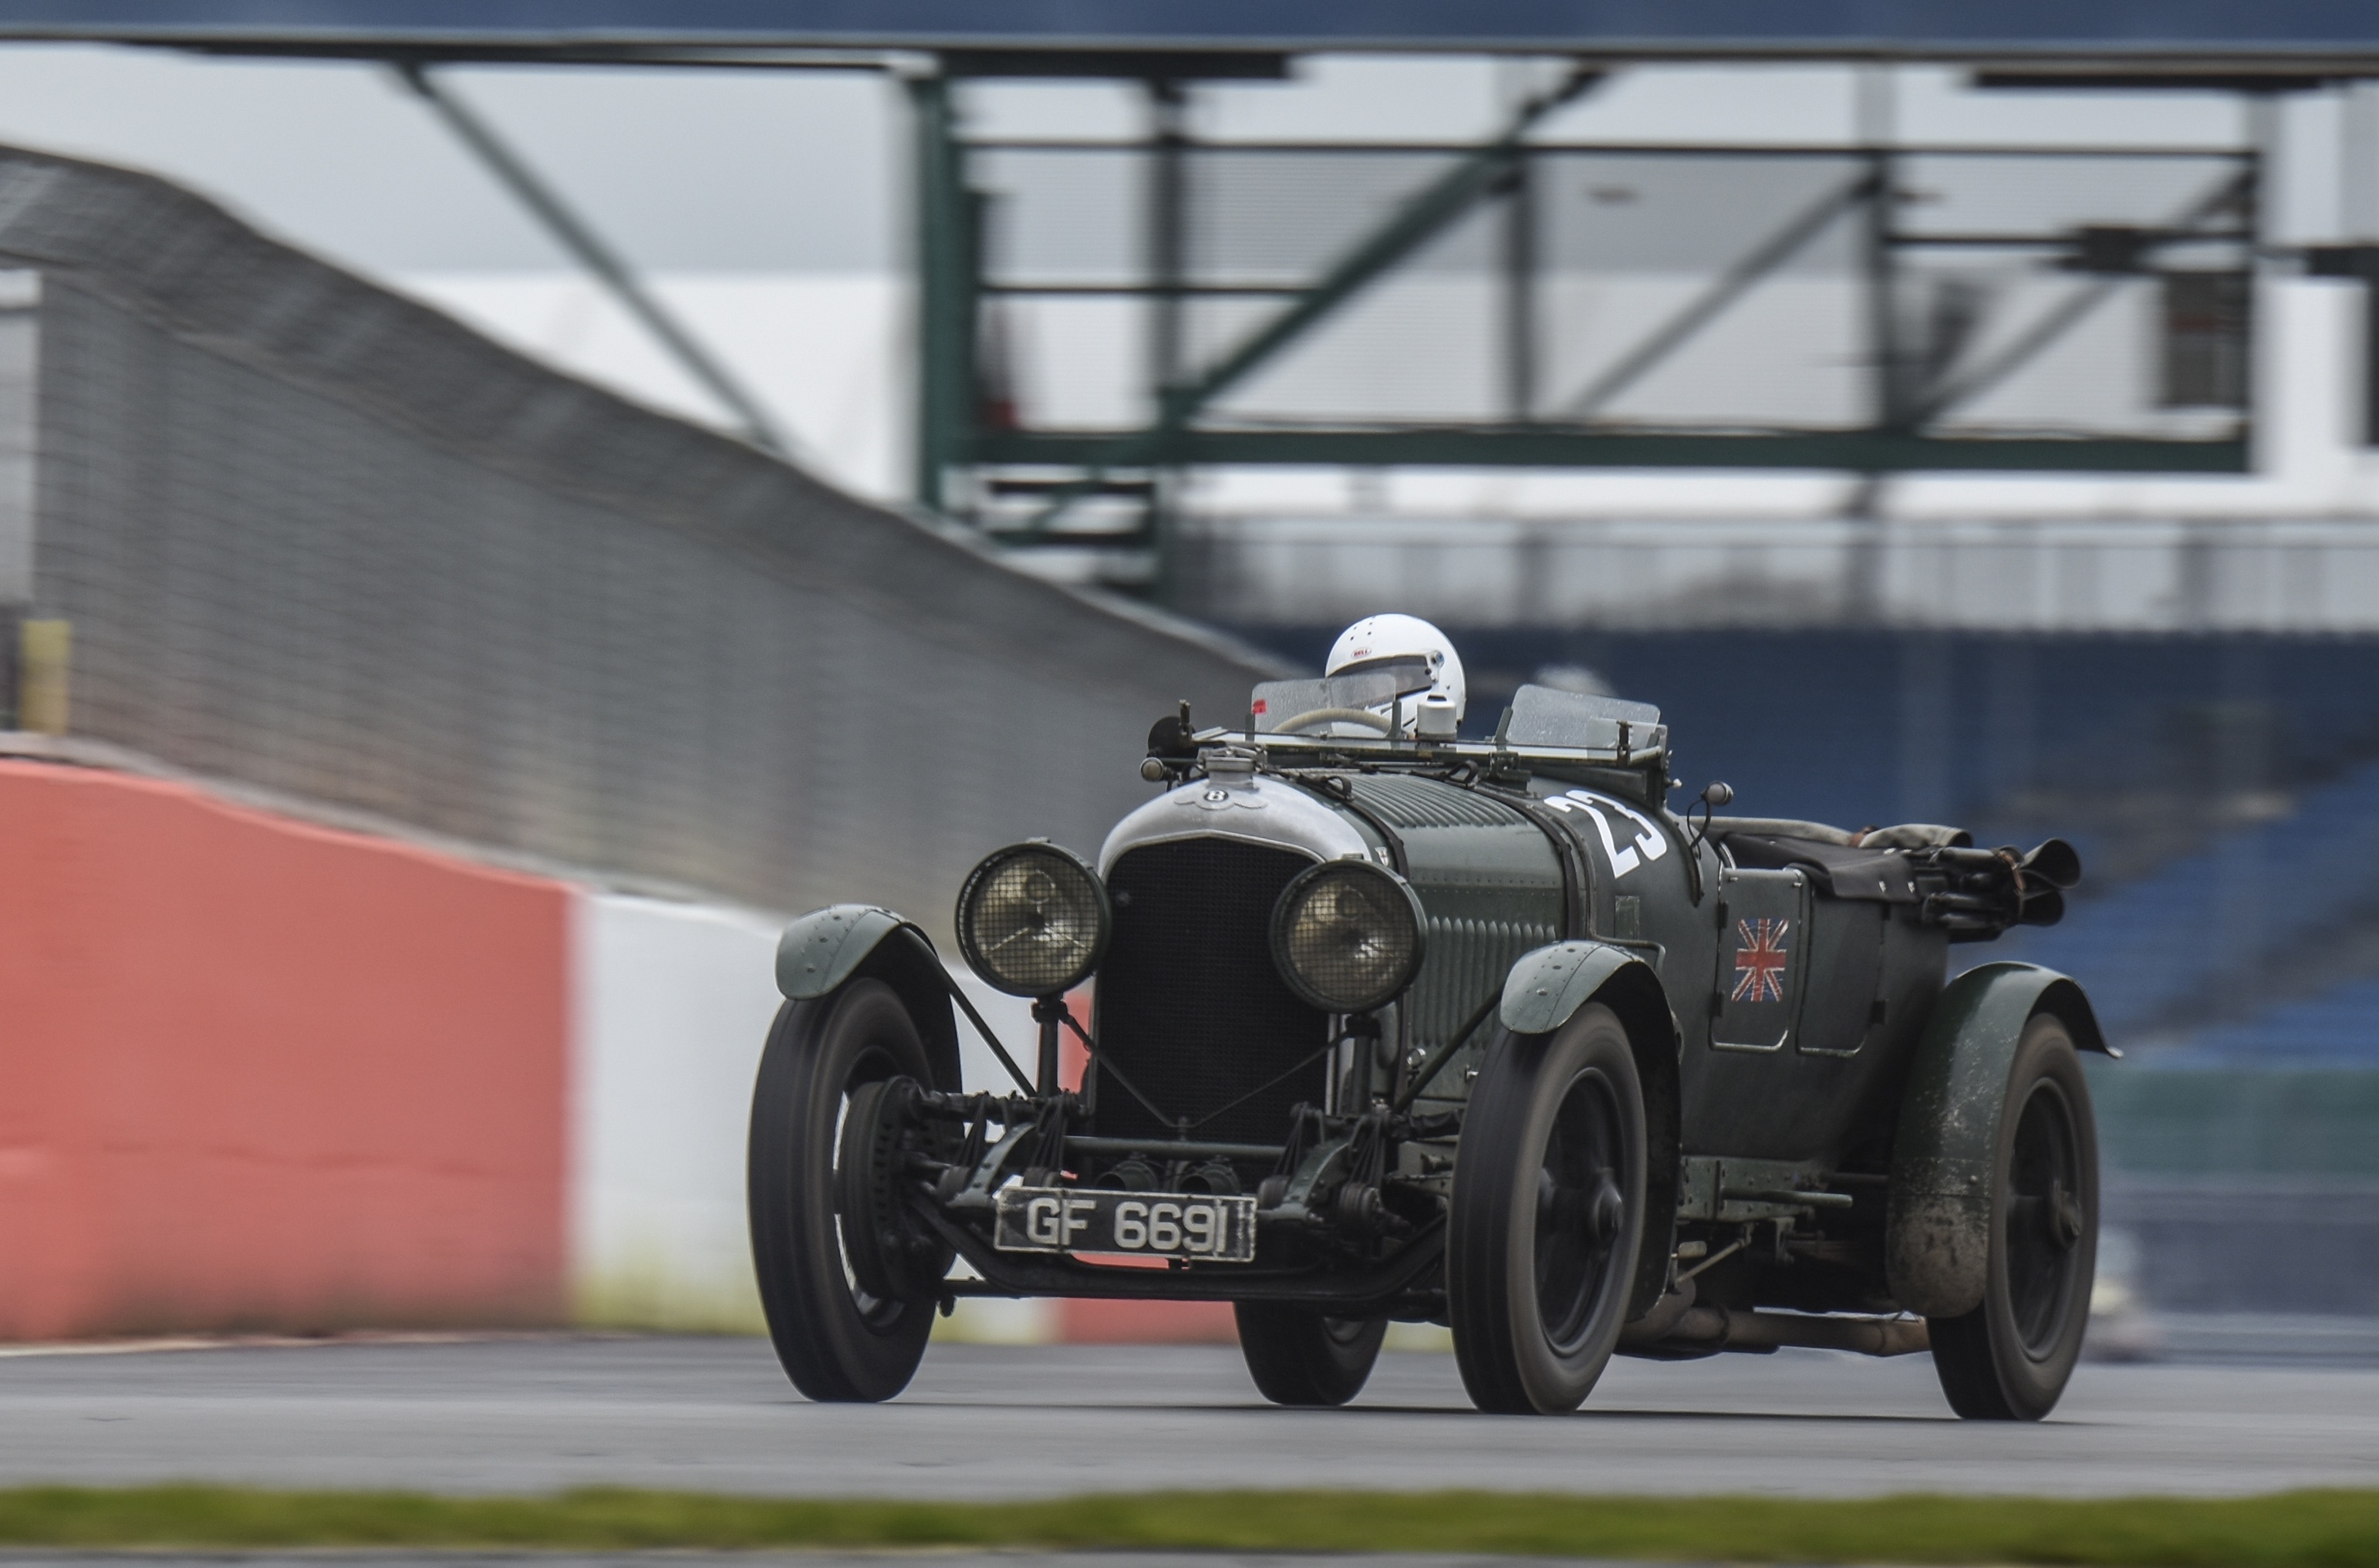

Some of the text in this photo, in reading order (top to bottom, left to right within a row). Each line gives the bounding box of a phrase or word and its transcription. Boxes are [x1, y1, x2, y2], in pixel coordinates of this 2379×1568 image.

[1207, 790, 1225, 801] B
[1544, 790, 1667, 878] 23
[1027, 1198, 1228, 1253] GF 6691
